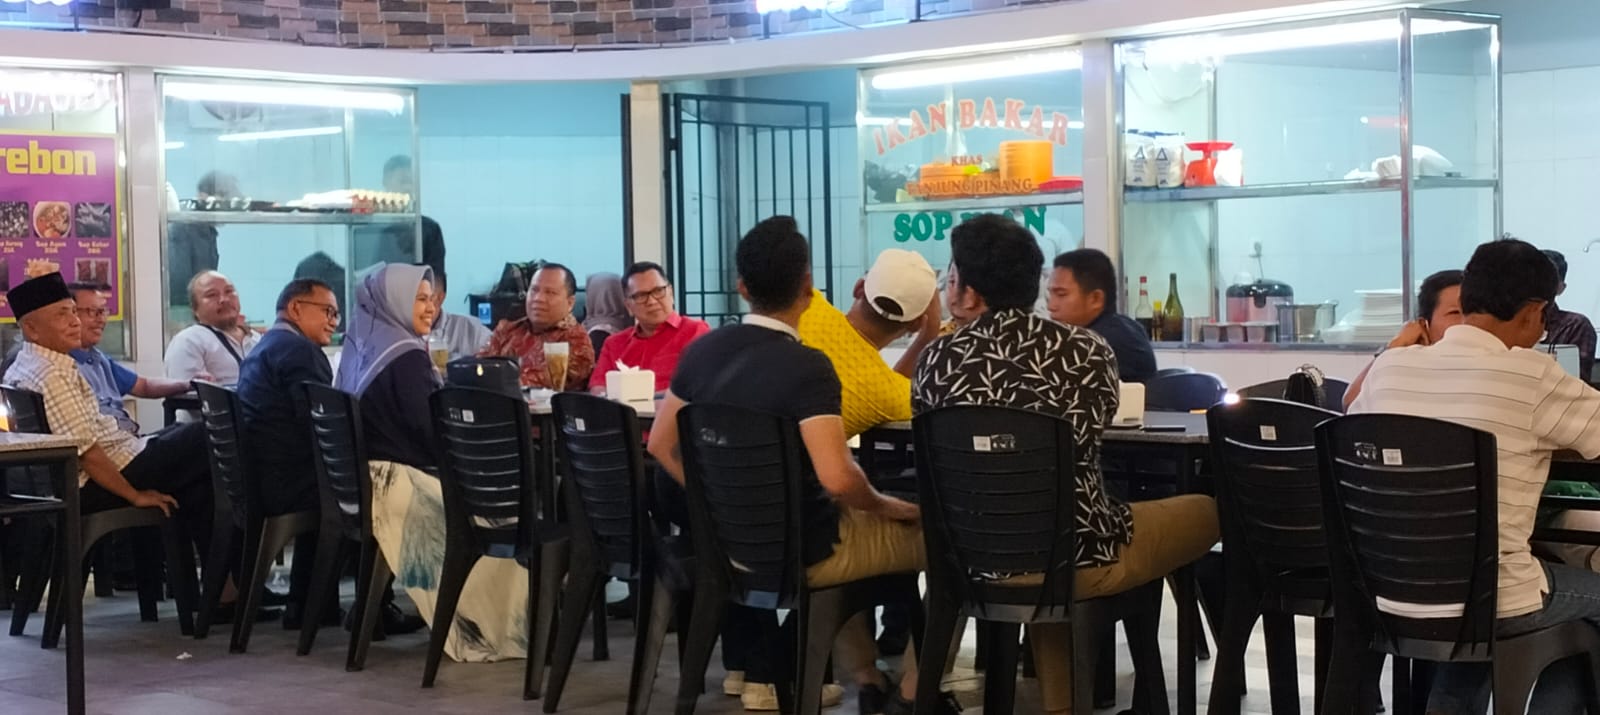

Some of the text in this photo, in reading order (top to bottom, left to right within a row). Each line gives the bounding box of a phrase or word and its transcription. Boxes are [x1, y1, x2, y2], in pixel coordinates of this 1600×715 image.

[873, 97, 1069, 154] IKAN BAKAR
[951, 154, 984, 166] KHAS
[906, 178, 1033, 195] TANJUNG PINANG
[894, 211, 952, 242] SOP
